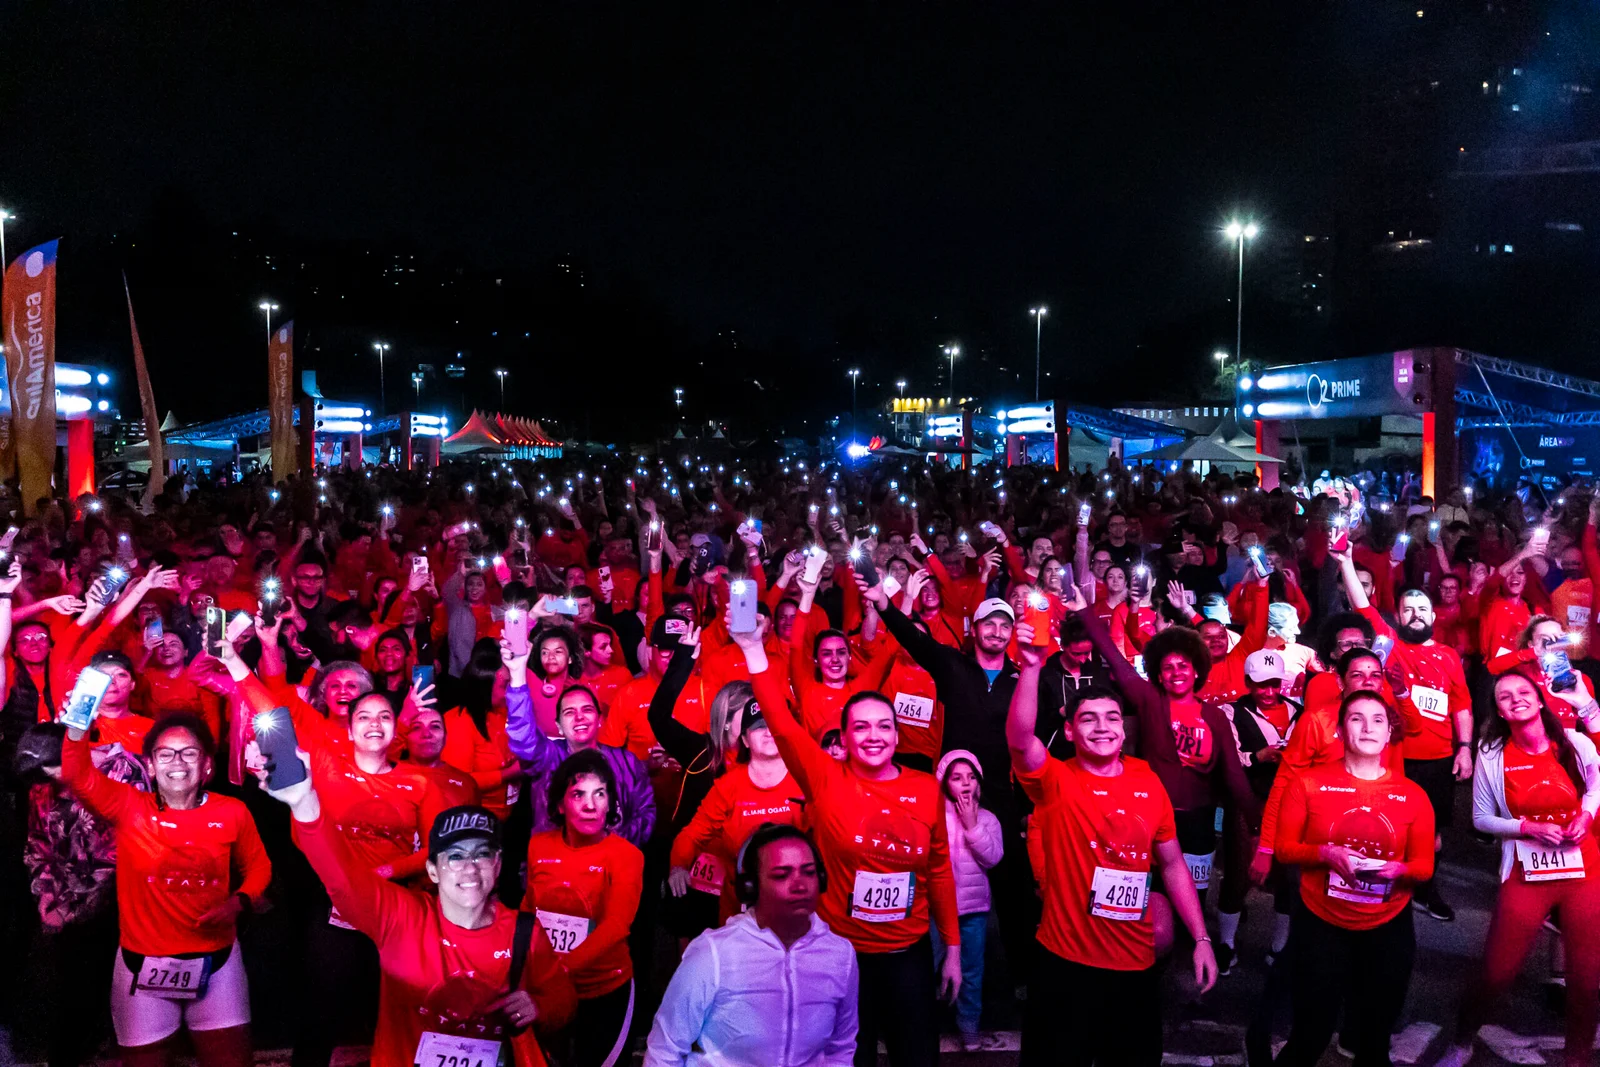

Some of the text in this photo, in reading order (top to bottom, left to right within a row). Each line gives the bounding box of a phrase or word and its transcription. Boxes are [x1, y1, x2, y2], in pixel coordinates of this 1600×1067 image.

[1331, 379, 1360, 398] PRIME
[1539, 434, 1558, 448] ÁREA
[896, 702, 922, 718] 7454
[768, 806, 791, 814] OGATA
[855, 835, 923, 855] STARS
[1531, 851, 1566, 869] 8441
[863, 887, 900, 908] 4292
[1106, 885, 1139, 907] 4269
[544, 928, 577, 952] 532
[147, 968, 191, 987] 2749
